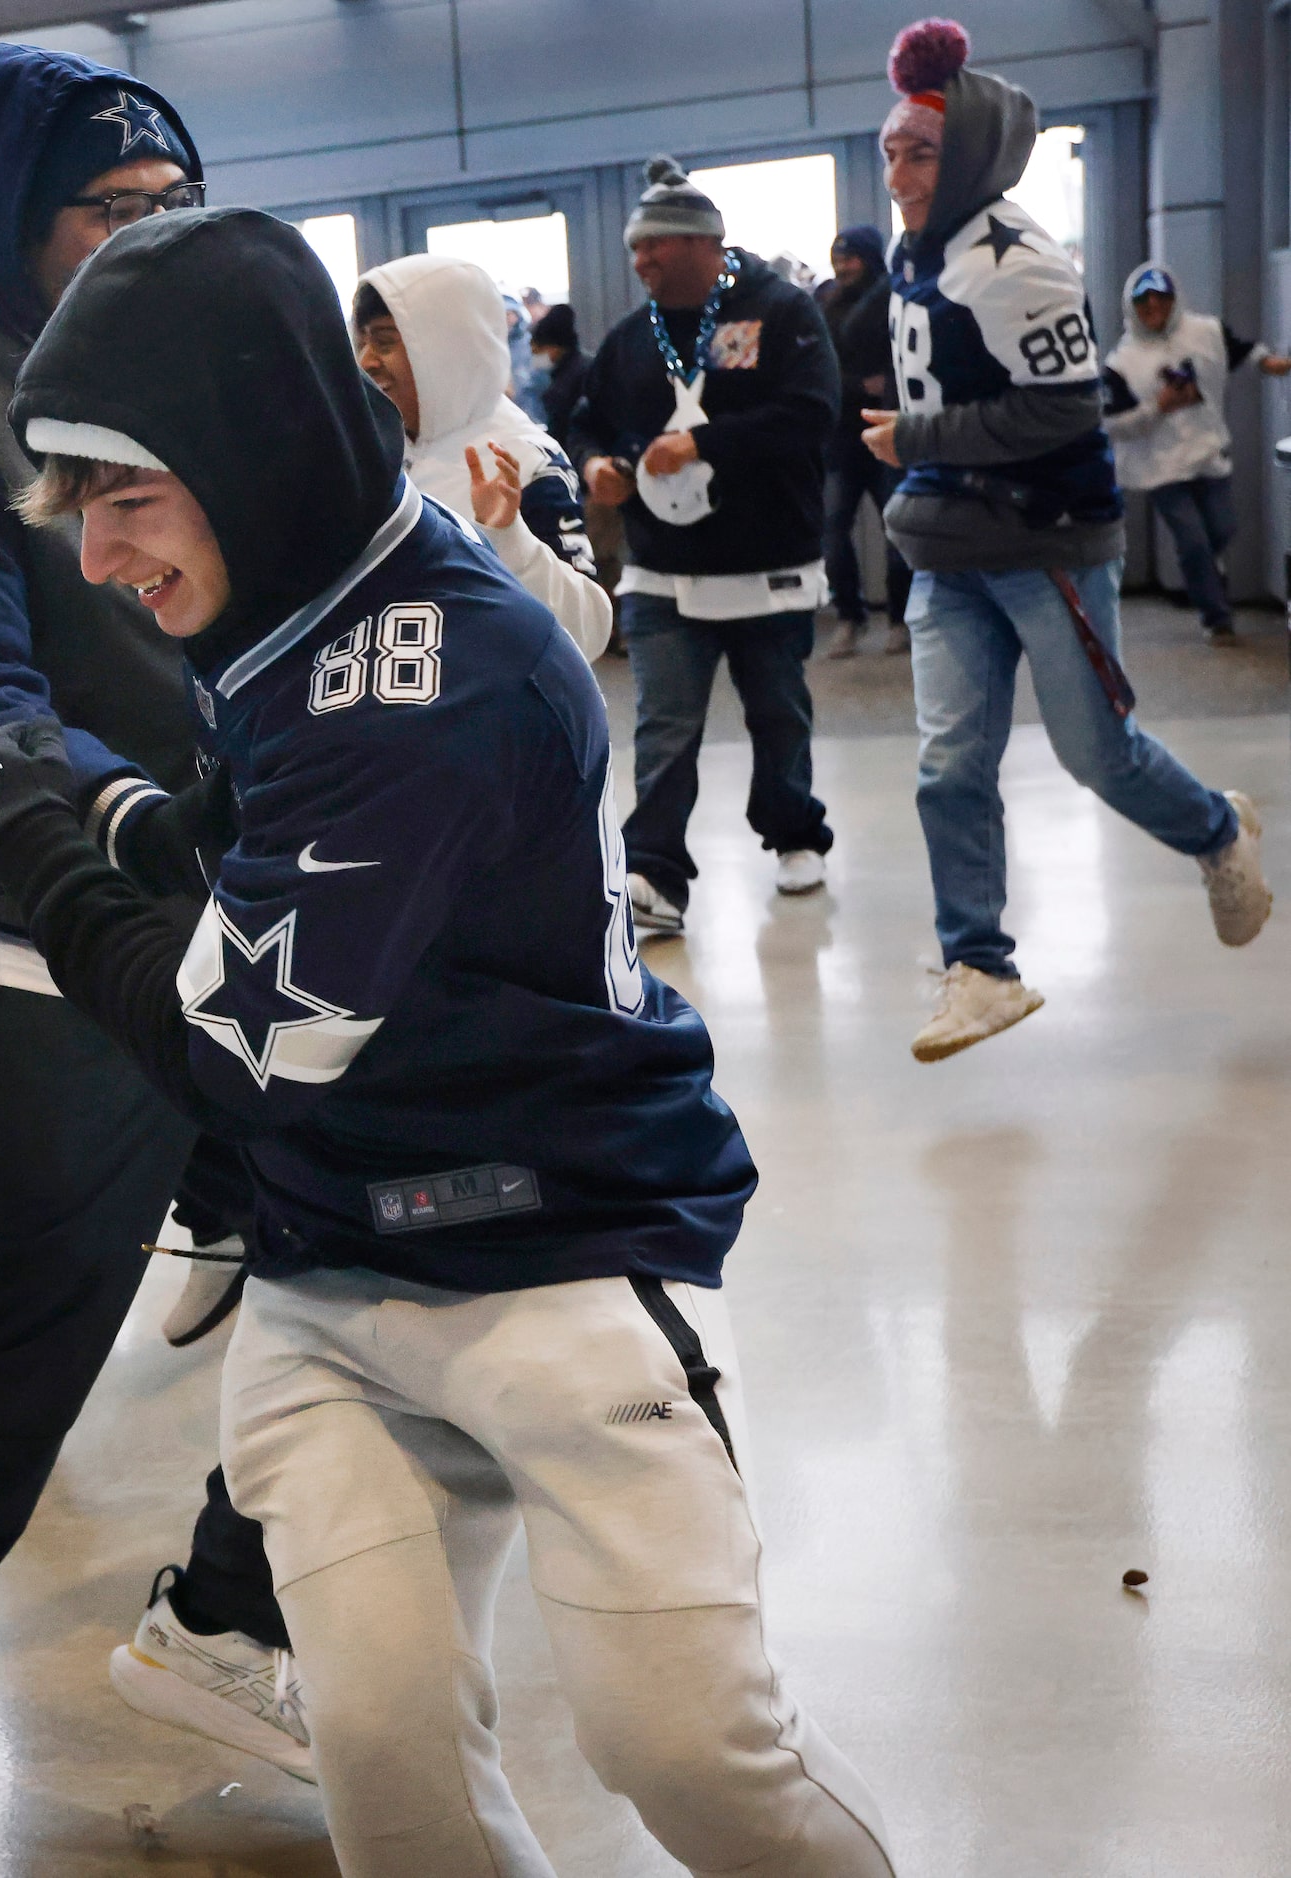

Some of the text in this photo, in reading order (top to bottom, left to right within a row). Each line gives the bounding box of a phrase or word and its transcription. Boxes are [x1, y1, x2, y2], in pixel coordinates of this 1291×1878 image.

[1019, 312, 1089, 377] 88
[307, 601, 444, 716] 88
[450, 1174, 478, 1198] M
